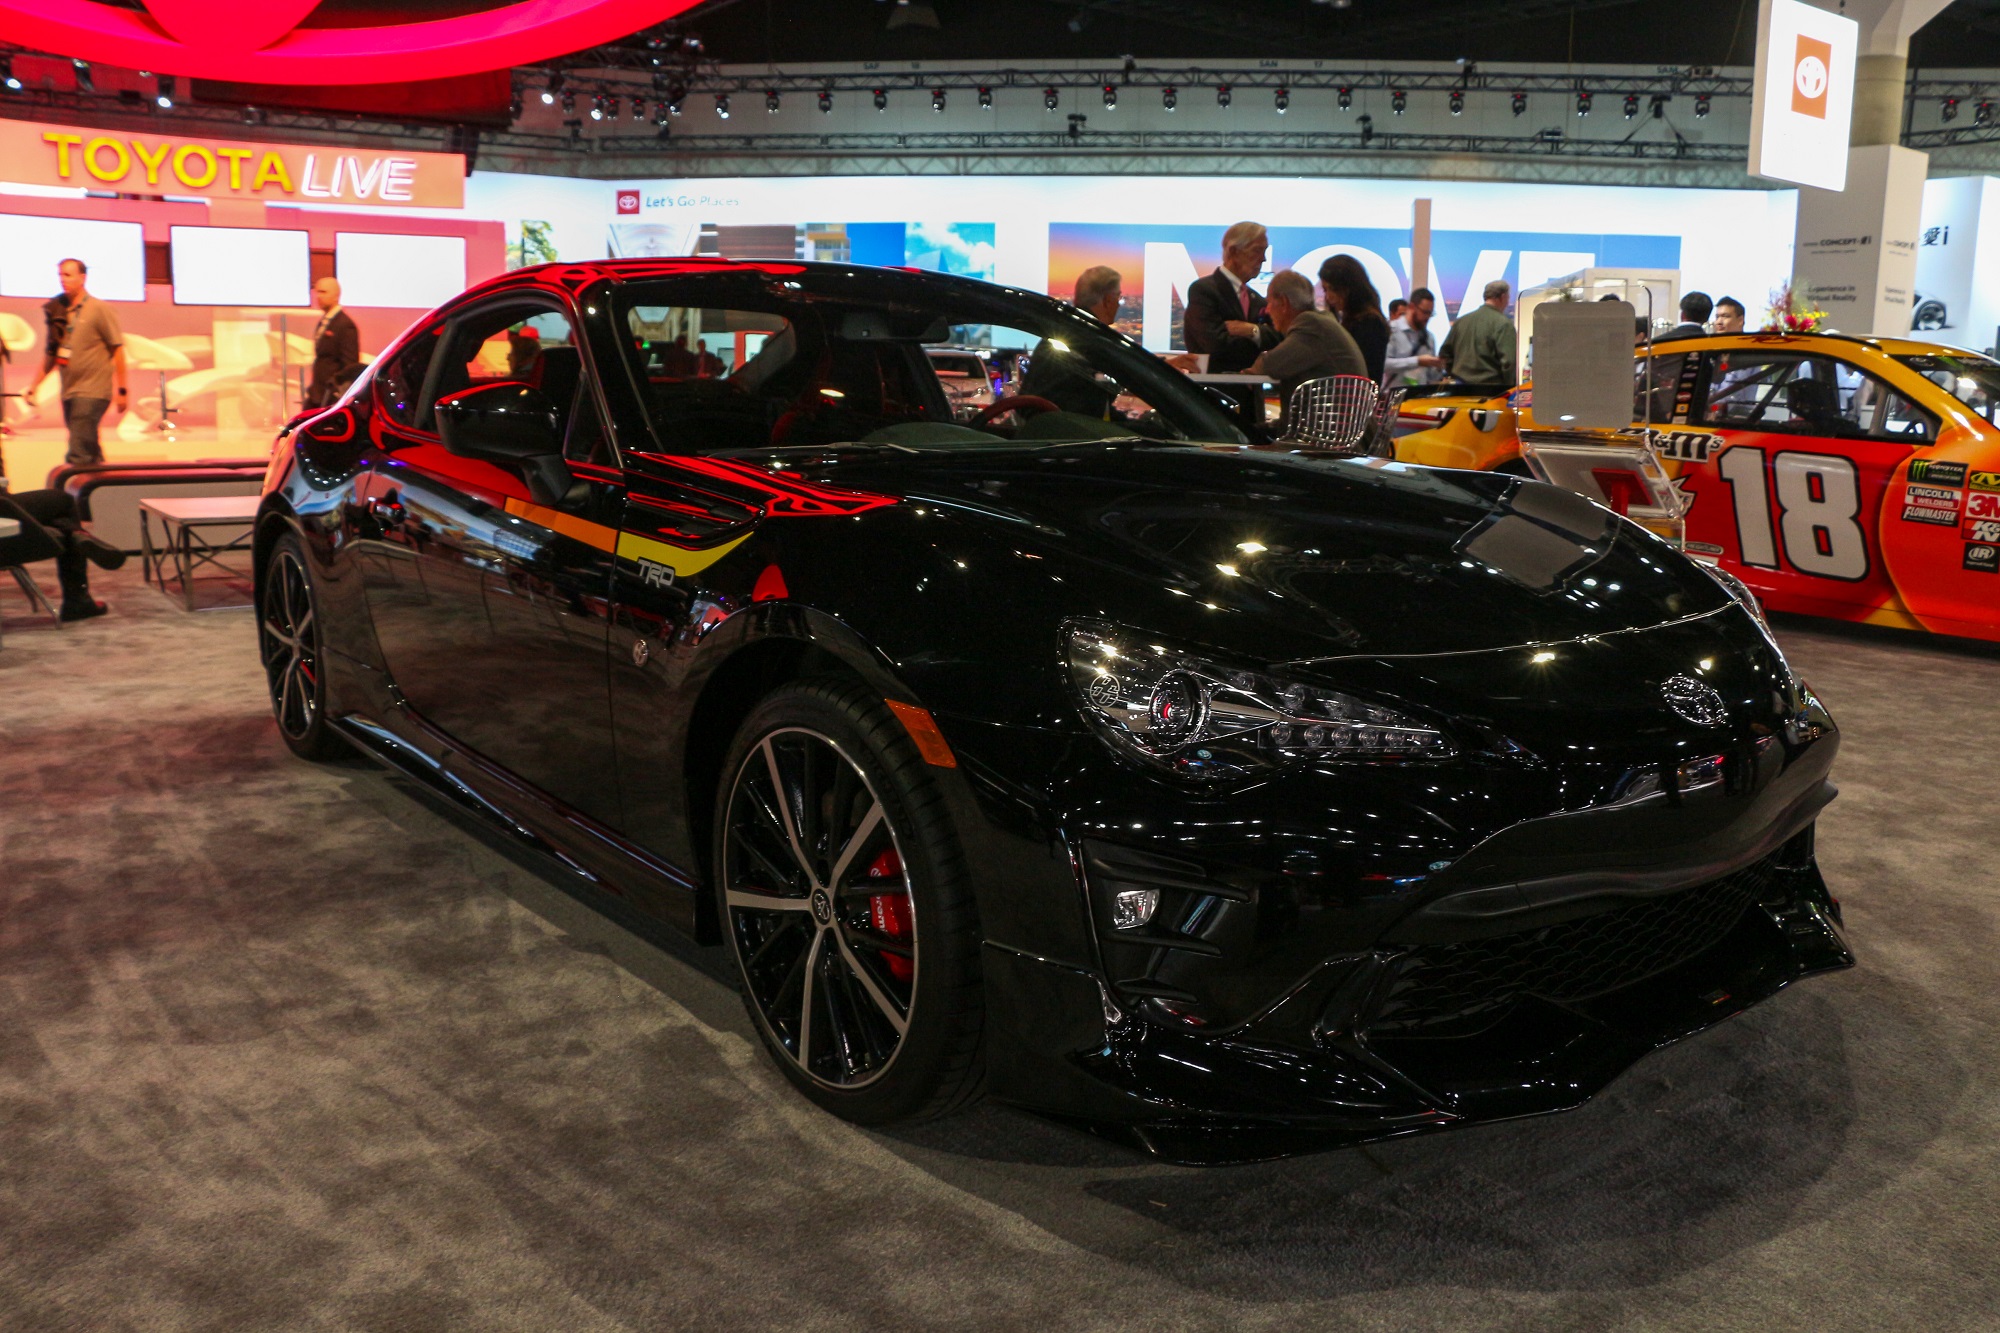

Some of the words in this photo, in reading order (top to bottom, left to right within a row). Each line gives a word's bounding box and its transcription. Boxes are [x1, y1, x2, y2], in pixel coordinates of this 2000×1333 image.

[43, 132, 294, 193] TOYOTA
[301, 154, 417, 200] LIVE
[646, 196, 674, 208] Let's
[677, 196, 696, 207] Go
[699, 195, 740, 206] Places
[1909, 487, 1953, 499] LINCOLN
[1917, 497, 1954, 508] WELDERS
[1718, 446, 1869, 581] 18
[1903, 506, 1957, 521] FLOWMASTER
[1972, 547, 1990, 559] IR
[638, 559, 675, 588] TRD
